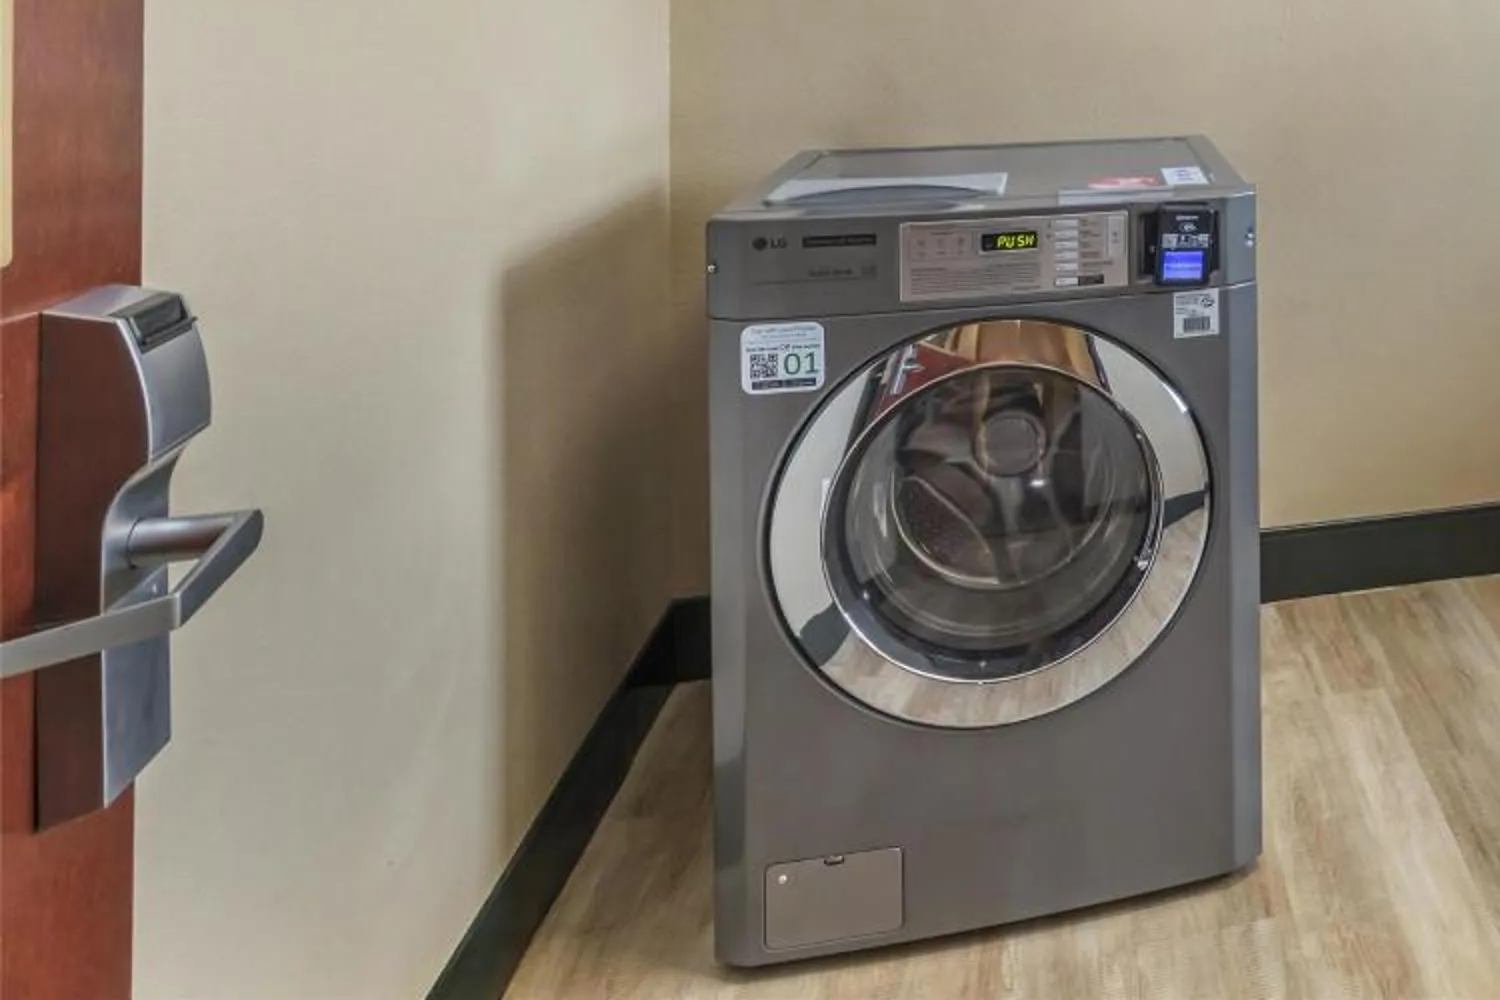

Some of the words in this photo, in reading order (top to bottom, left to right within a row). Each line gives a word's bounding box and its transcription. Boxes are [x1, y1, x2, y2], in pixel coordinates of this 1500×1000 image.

[770, 237, 787, 249] LG
[997, 235, 1034, 248] PUSH
[784, 351, 819, 375] 01
